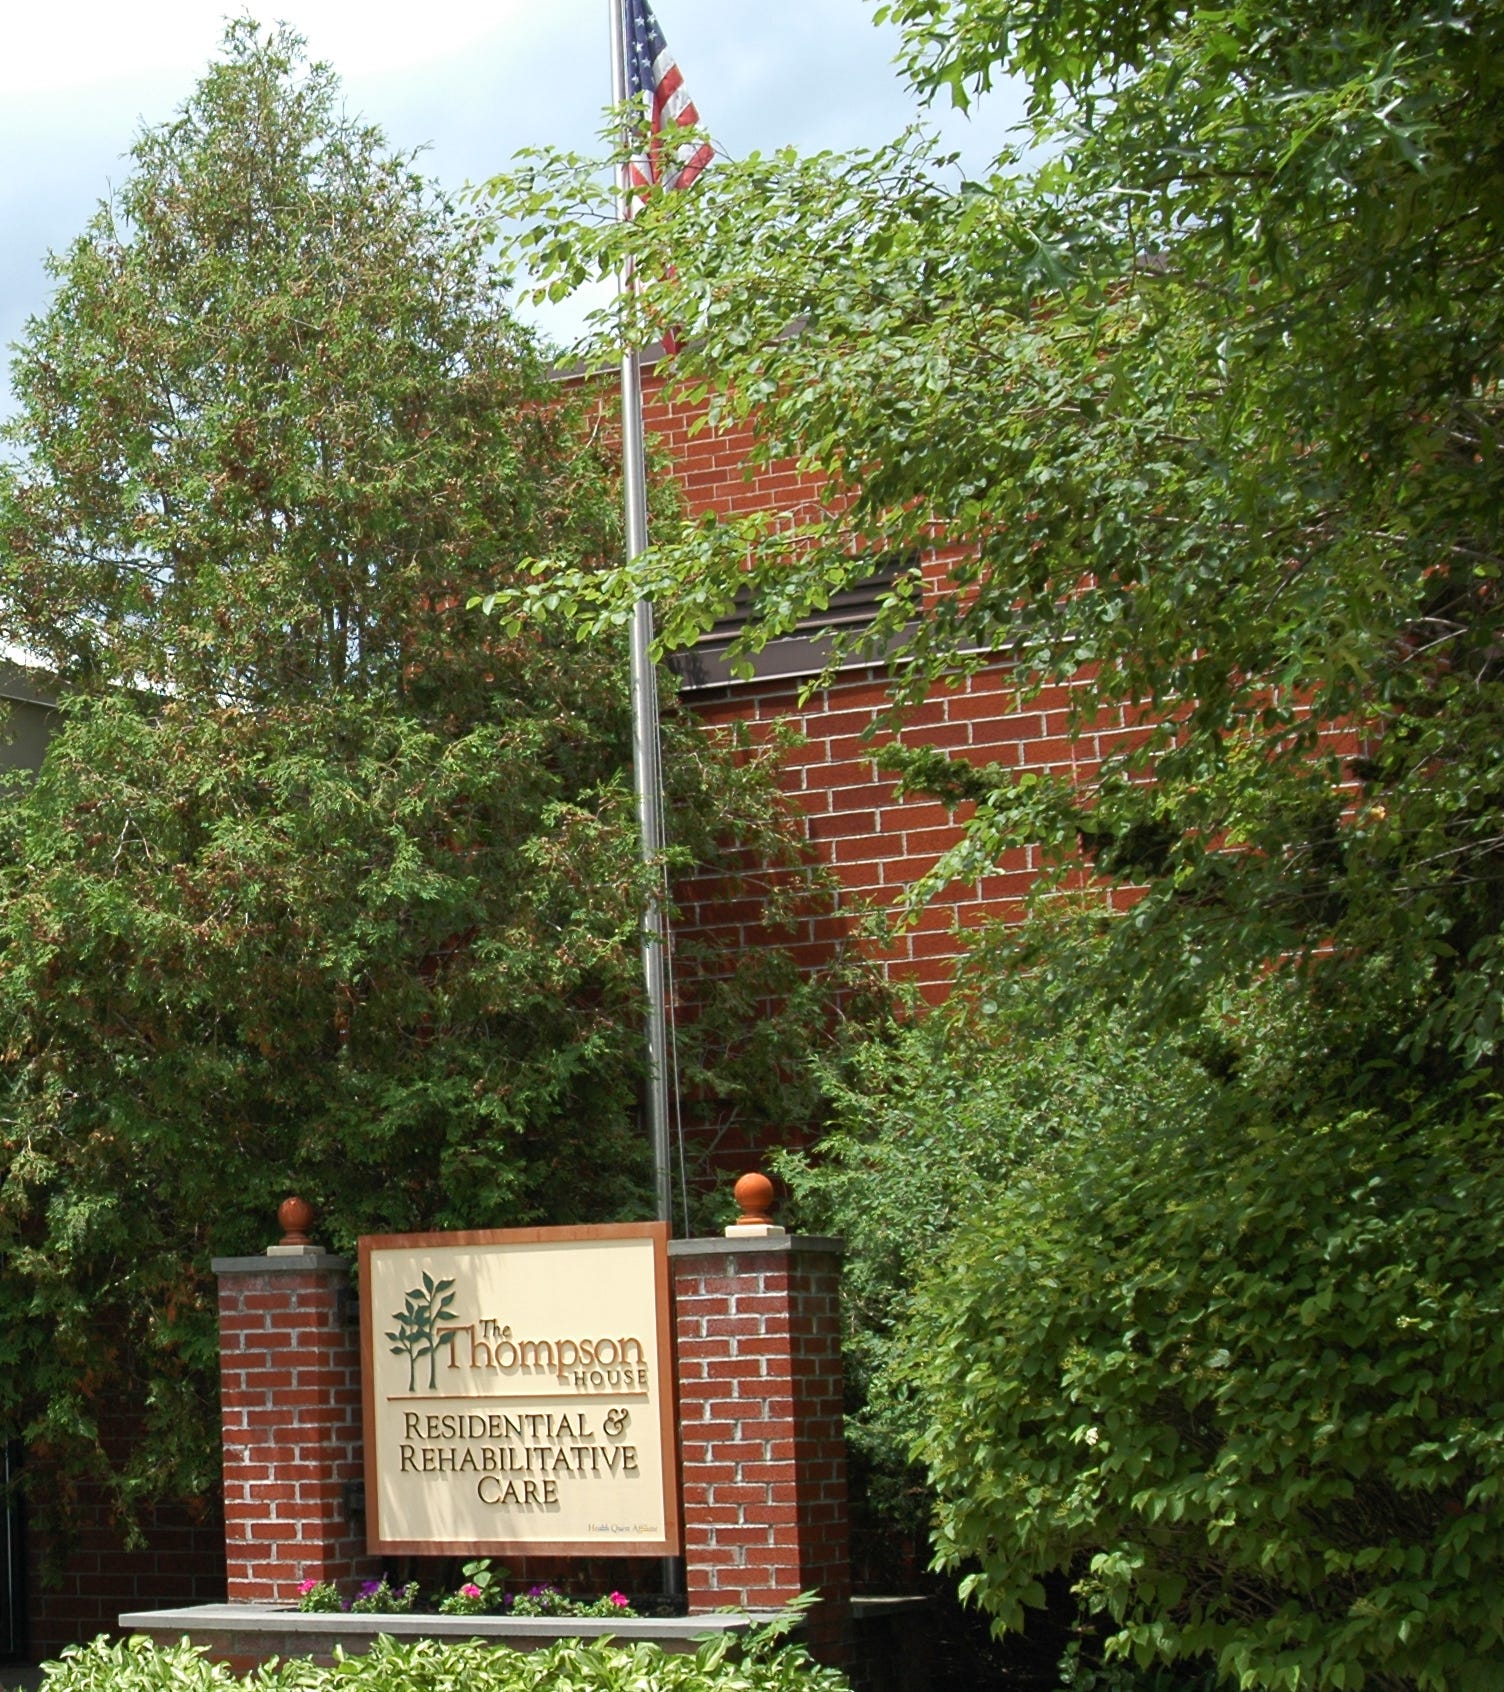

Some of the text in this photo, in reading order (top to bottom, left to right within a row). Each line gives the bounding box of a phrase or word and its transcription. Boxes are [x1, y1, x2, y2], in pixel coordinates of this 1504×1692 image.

[479, 1318, 511, 1338] The
[436, 1324, 646, 1378] Thompson
[574, 1368, 648, 1386] HOUSE
[404, 1408, 628, 1440] RESIDENTIAL &
[400, 1444, 638, 1473] REHABILITATIVE
[477, 1475, 559, 1504] CARE
